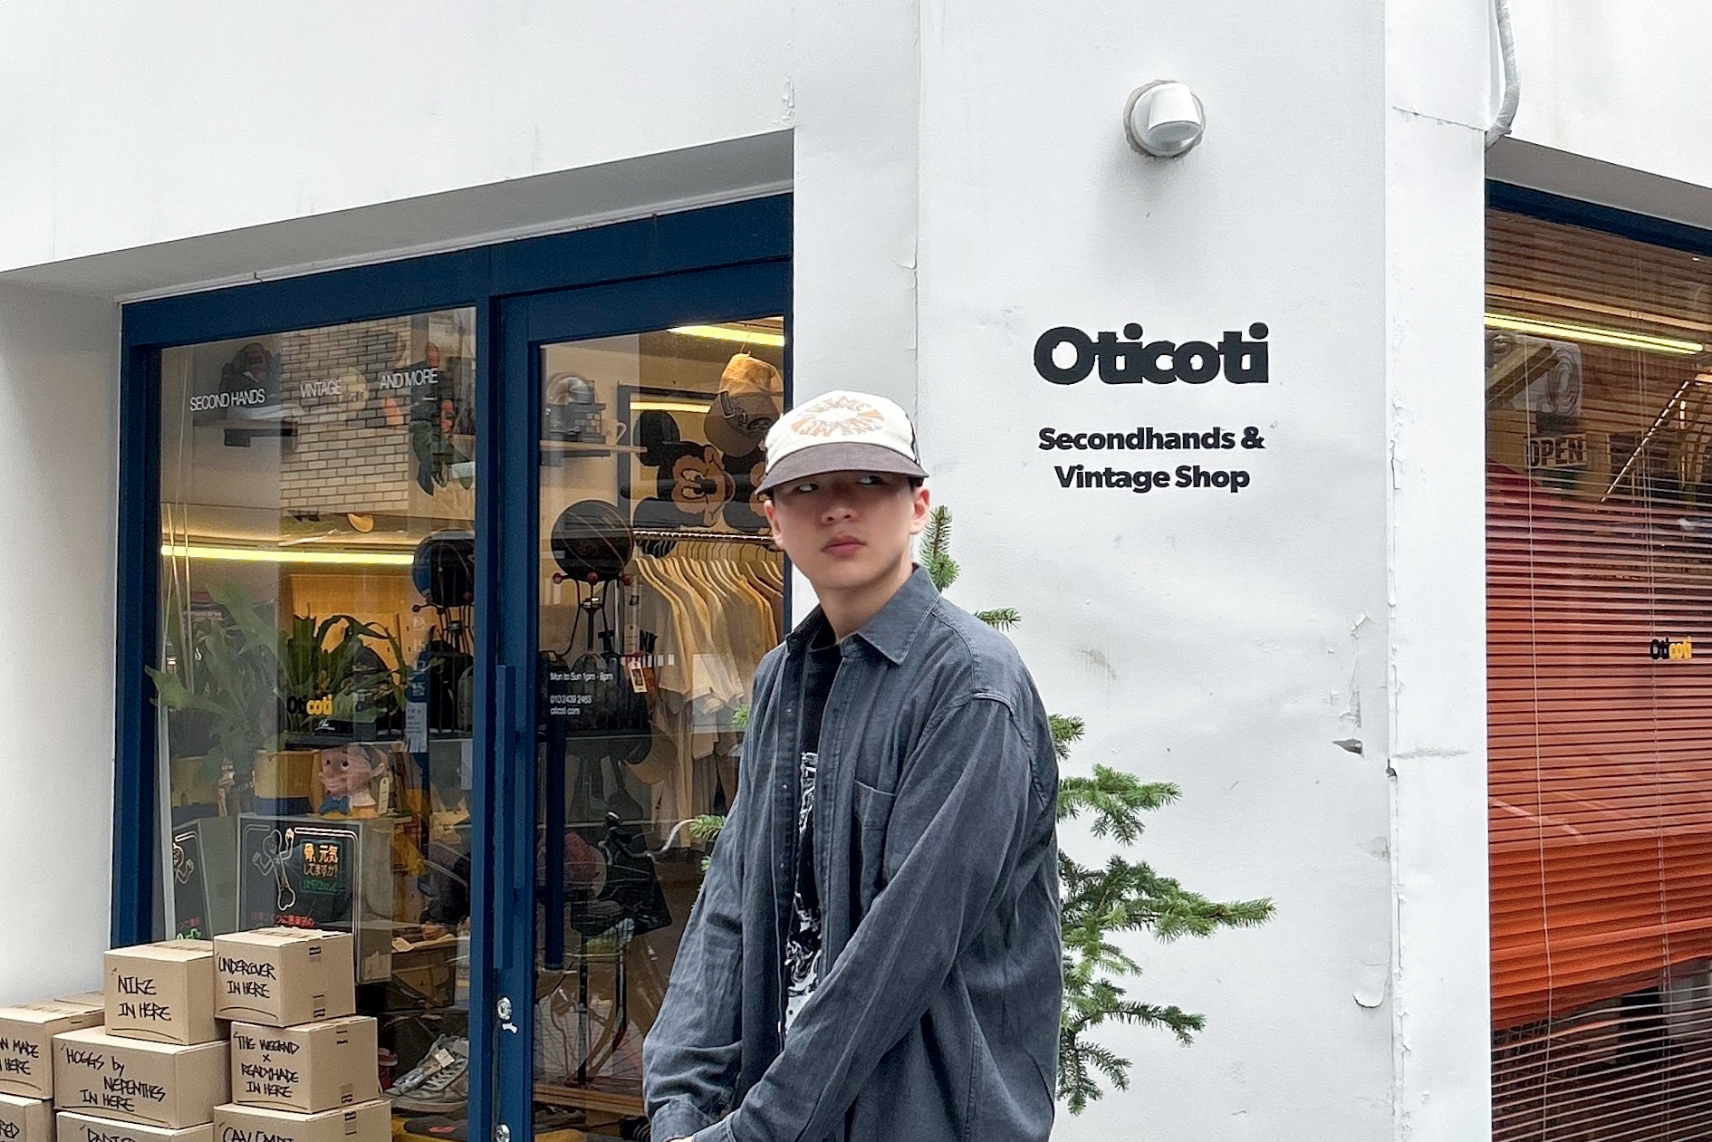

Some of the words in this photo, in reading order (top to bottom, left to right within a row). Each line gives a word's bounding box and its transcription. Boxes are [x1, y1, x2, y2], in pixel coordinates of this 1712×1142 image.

[1034, 322, 1269, 385] Oticoti
[300, 380, 342, 398] VINTAGE
[380, 373, 404, 389] AND
[405, 368, 438, 386] MORE
[190, 393, 229, 411] SECOND
[231, 388, 265, 406] HANDS
[1038, 426, 1236, 450] Secondhands
[1240, 426, 1266, 450] &
[1526, 437, 1583, 467] OPEN
[1054, 464, 1170, 493] Vintage
[1175, 464, 1250, 493] Shop
[218, 956, 276, 980] UNDERCOVER
[118, 975, 157, 995] NIKE
[227, 981, 240, 995] IN
[243, 981, 270, 999] HERE
[118, 1003, 136, 1019] IN
[139, 1002, 172, 1021] HERE
[111, 1056, 124, 1077] by
[80, 1089, 98, 1105] IN
[102, 1093, 135, 1112] HERE
[246, 1081, 261, 1094] IN
[263, 1083, 293, 1098] HERE
